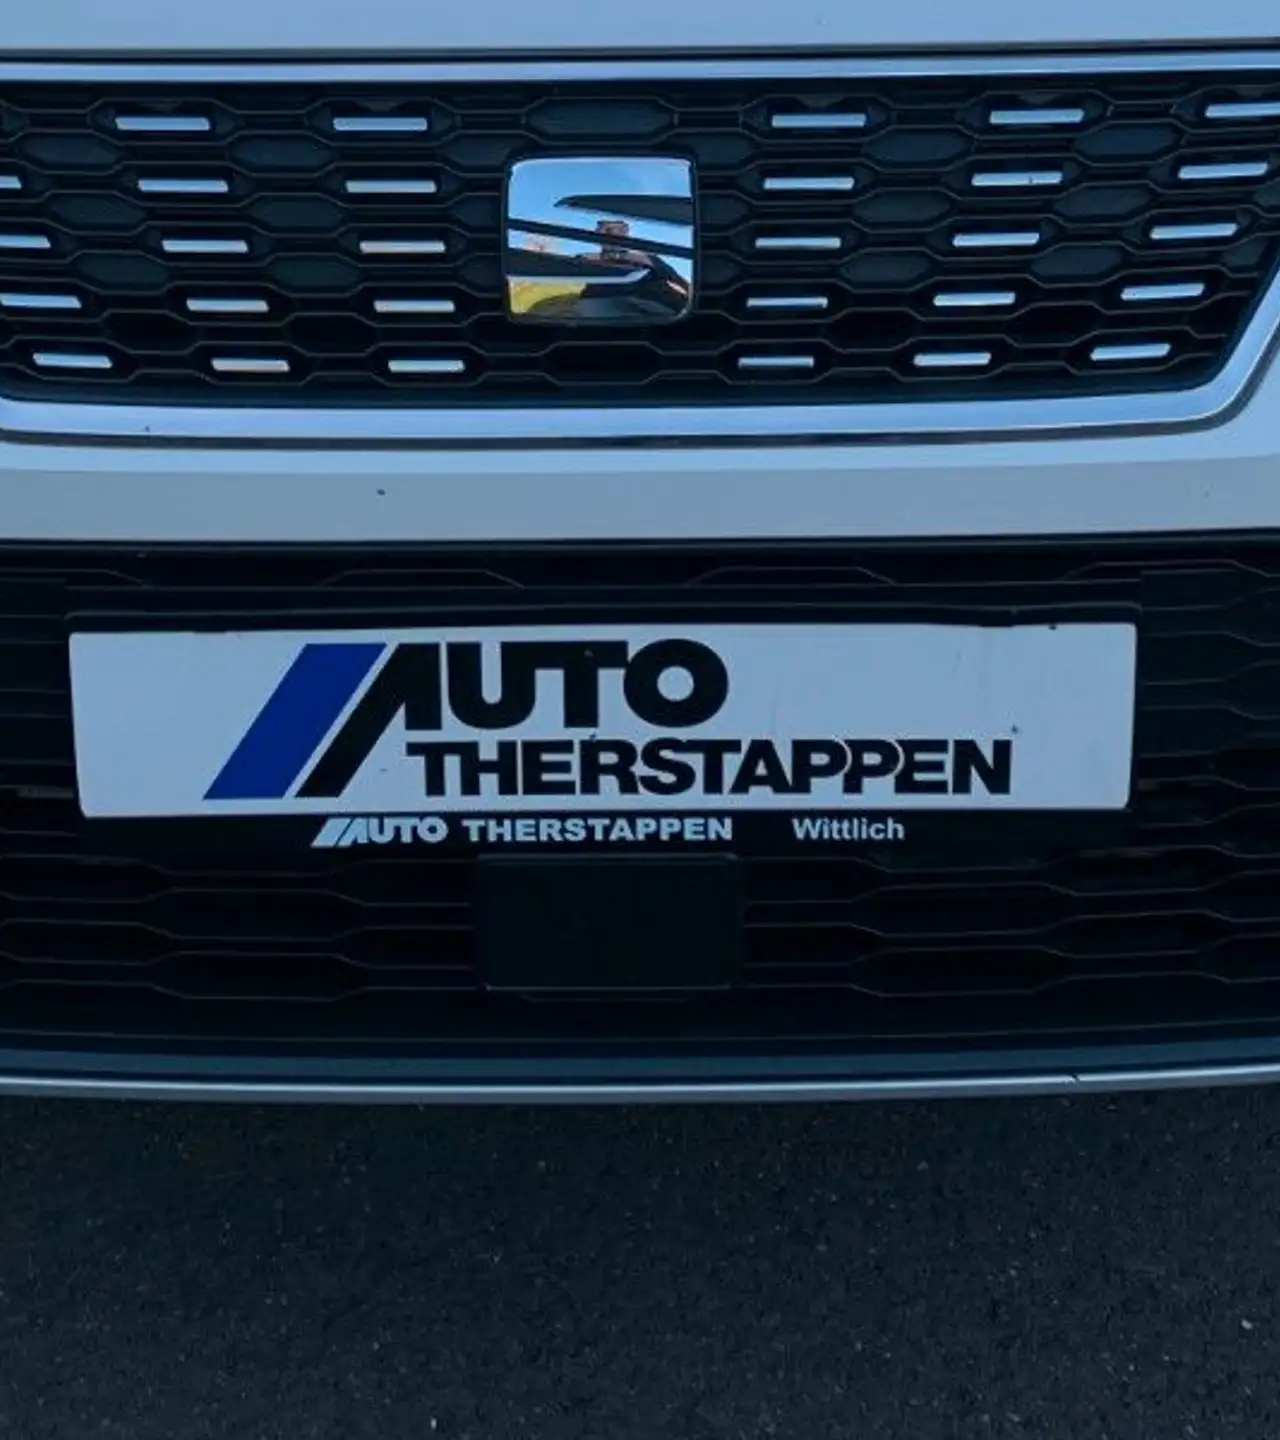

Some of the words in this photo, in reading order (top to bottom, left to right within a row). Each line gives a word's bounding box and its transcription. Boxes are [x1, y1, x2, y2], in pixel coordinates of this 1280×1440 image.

[295, 638, 729, 799] AUTO
[406, 737, 1013, 798] THERSTAPPEN
[332, 816, 449, 848] AUTO
[462, 817, 733, 843] THERSTAPPEN
[792, 817, 905, 841] Wittlich
